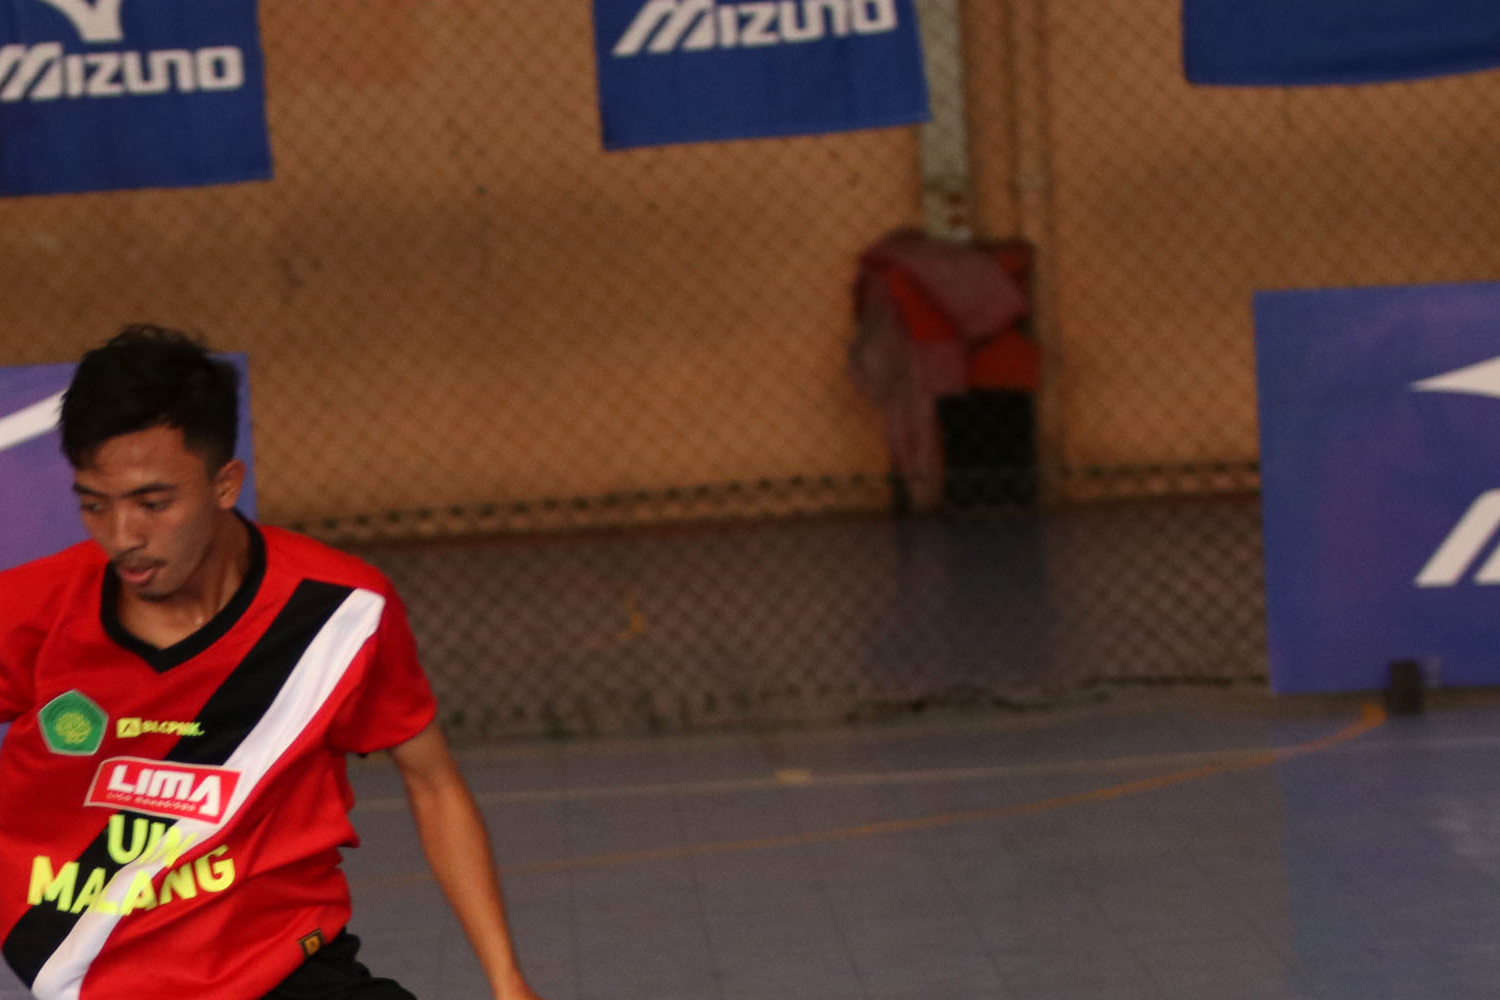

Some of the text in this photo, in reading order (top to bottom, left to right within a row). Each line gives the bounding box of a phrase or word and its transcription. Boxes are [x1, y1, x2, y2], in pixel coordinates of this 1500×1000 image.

[611, 0, 897, 57] MIZUNO
[107, 764, 221, 817] LIMA
[27, 845, 236, 916] MALANG
